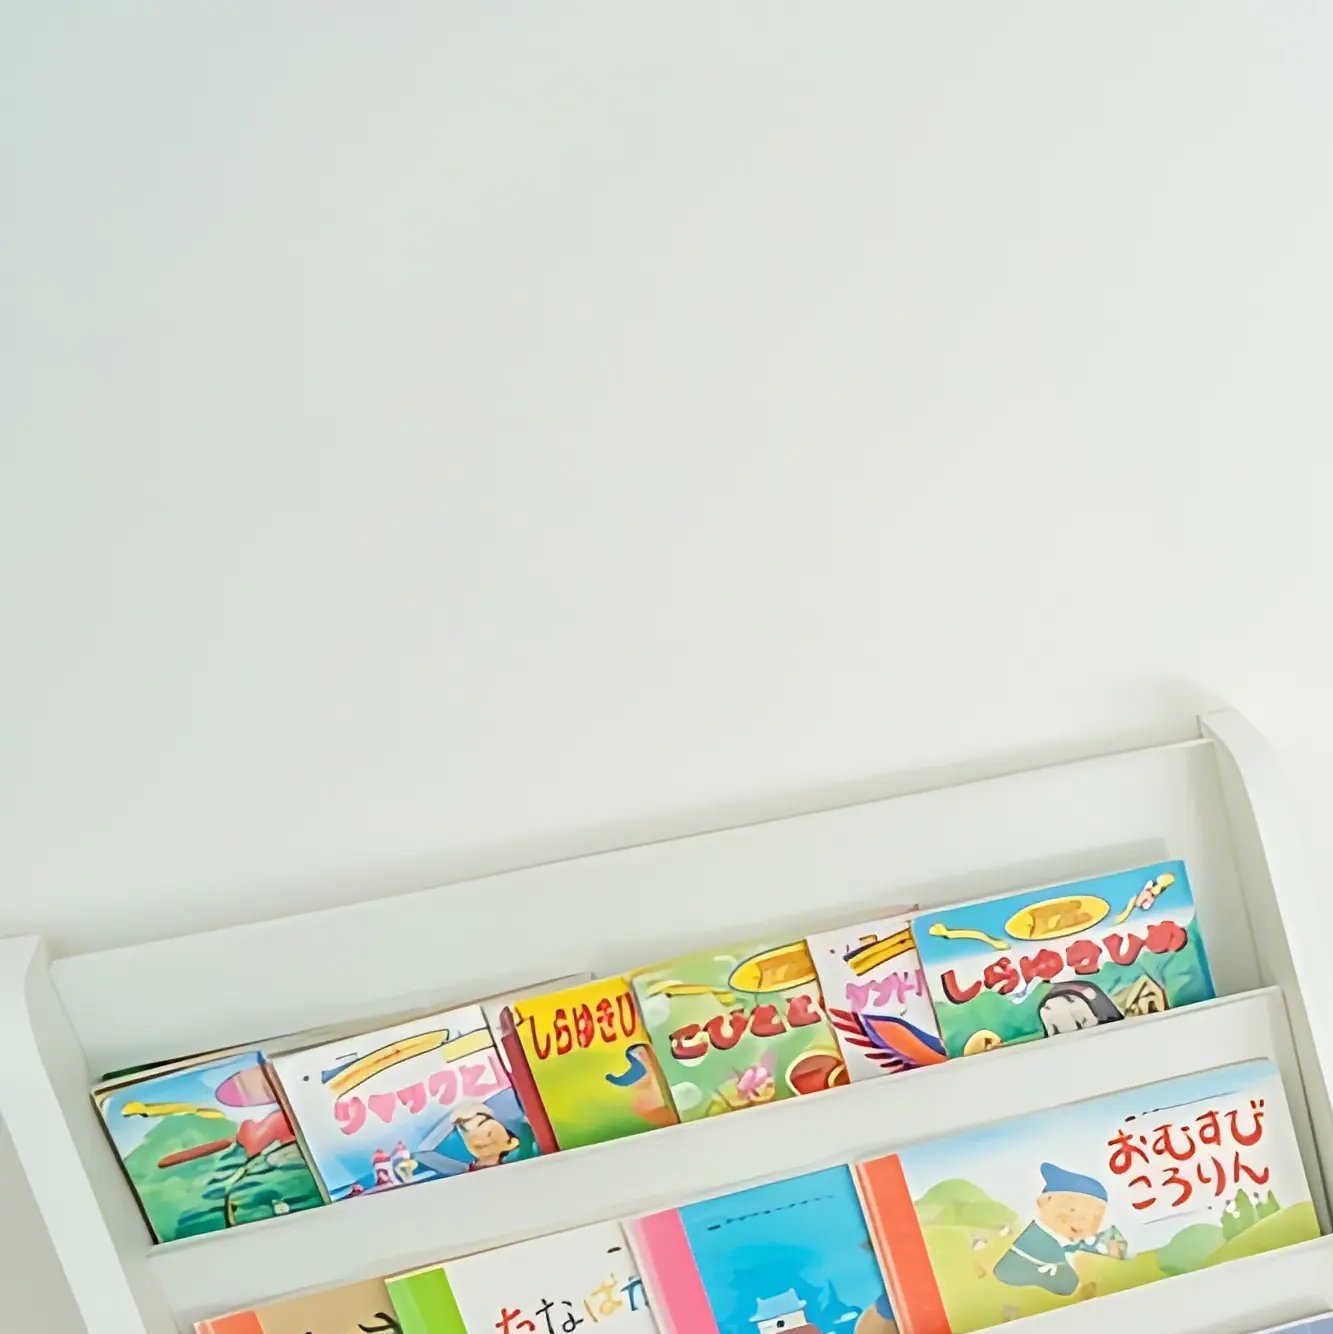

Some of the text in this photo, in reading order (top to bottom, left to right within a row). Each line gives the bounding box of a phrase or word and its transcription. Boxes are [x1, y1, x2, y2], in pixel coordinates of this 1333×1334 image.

[941, 920, 1187, 1004] しらゆきひめ
[334, 1055, 511, 1135] ジャックと
[1108, 1099, 1264, 1174] おむすび
[1128, 1151, 1269, 1209] ころりん
